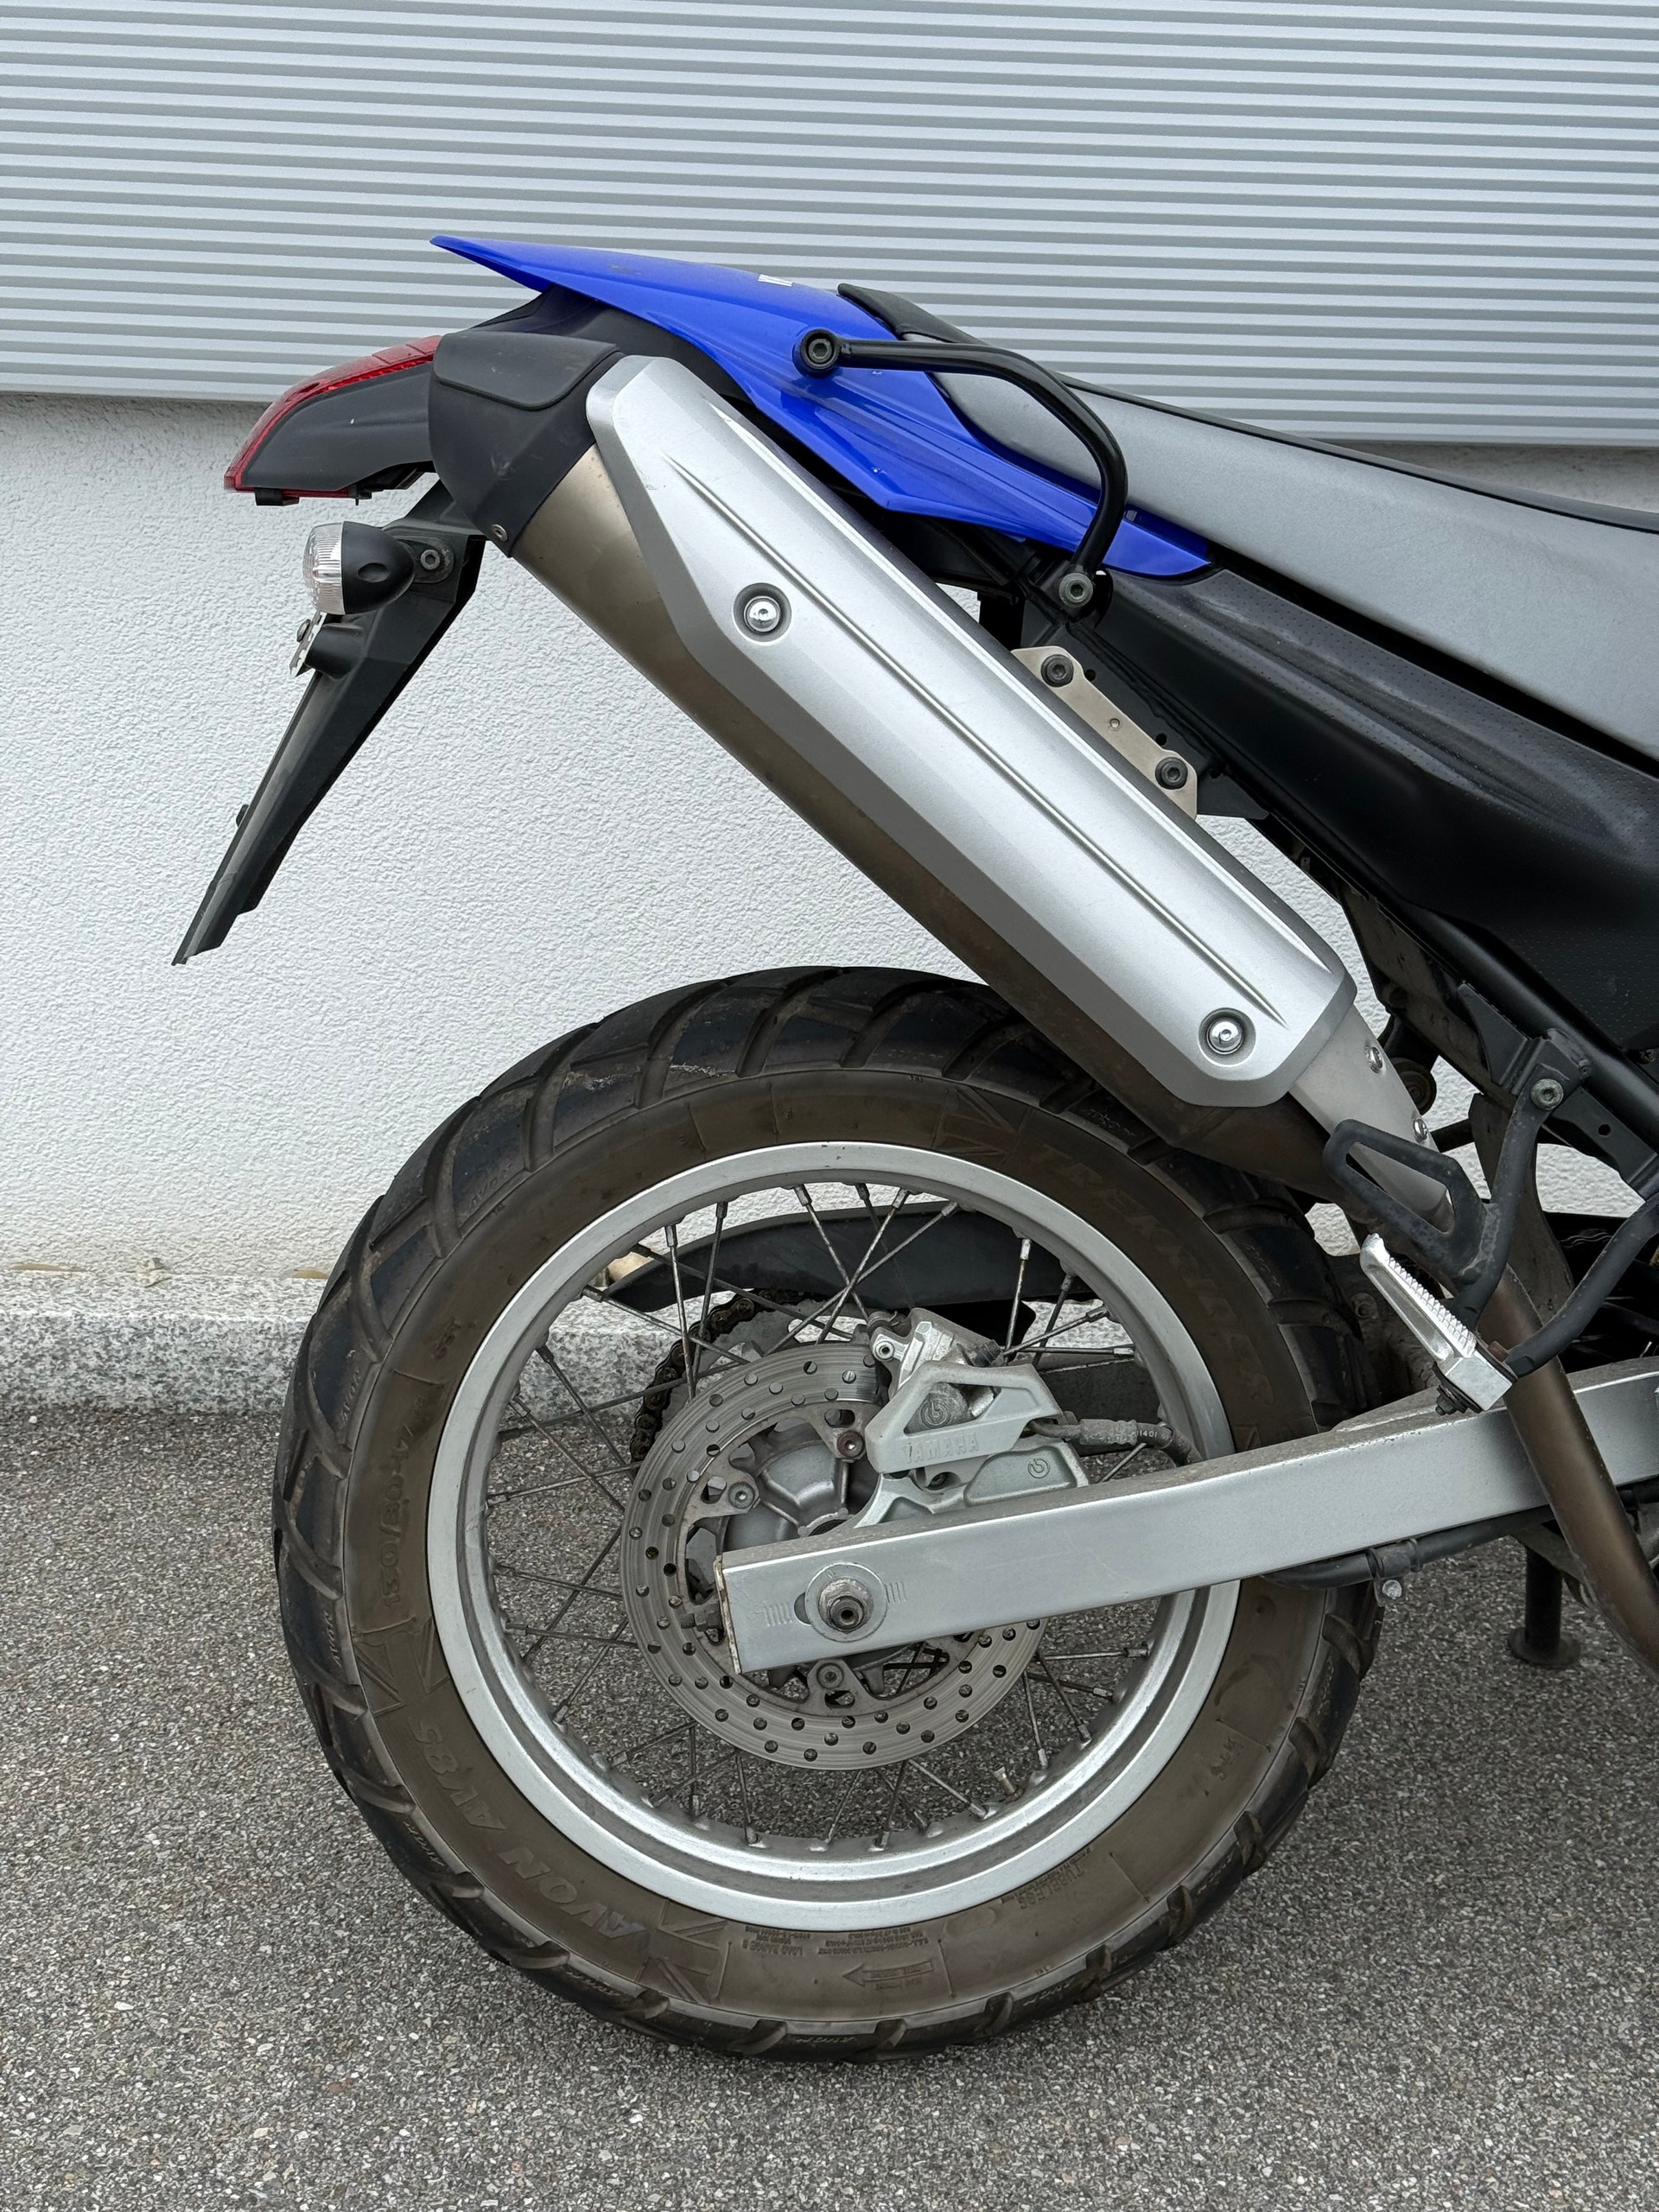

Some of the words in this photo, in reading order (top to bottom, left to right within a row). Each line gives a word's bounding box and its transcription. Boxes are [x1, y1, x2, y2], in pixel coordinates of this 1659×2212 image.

[902, 1433, 979, 1464] YAMAHA
[412, 1719, 506, 1831] AV85
[498, 1846, 645, 1940] AVON
[1019, 1862, 1085, 1909] TUBELESS
